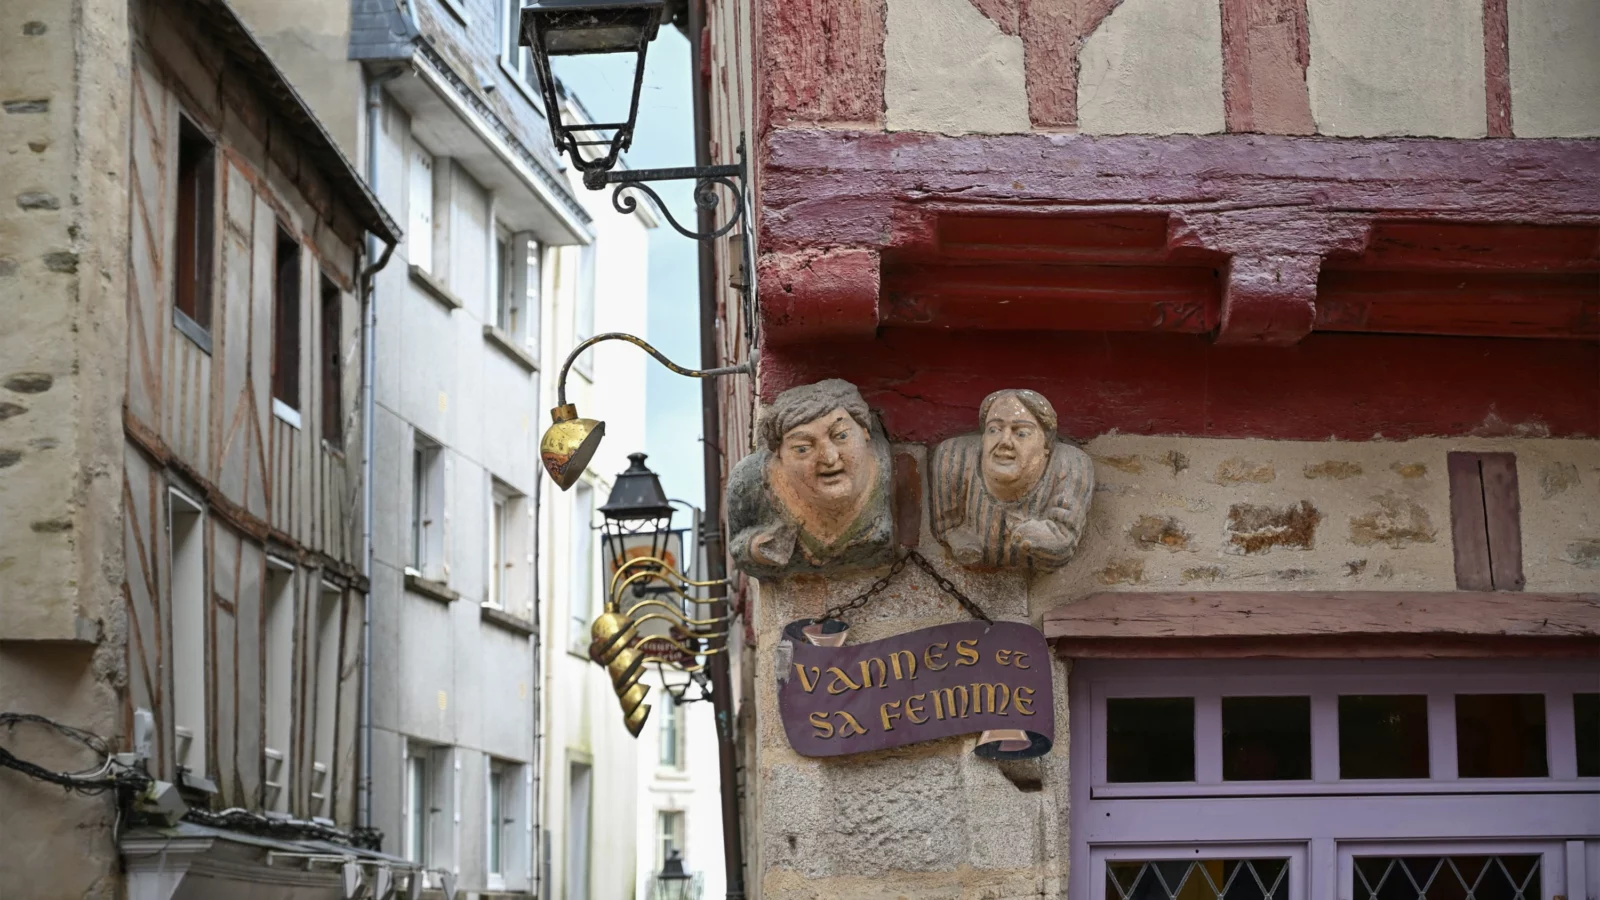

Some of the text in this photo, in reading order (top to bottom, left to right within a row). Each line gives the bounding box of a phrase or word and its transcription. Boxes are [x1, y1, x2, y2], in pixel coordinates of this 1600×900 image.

[793, 639, 980, 695] VANNES
[809, 682, 1037, 738] SA FEMME
